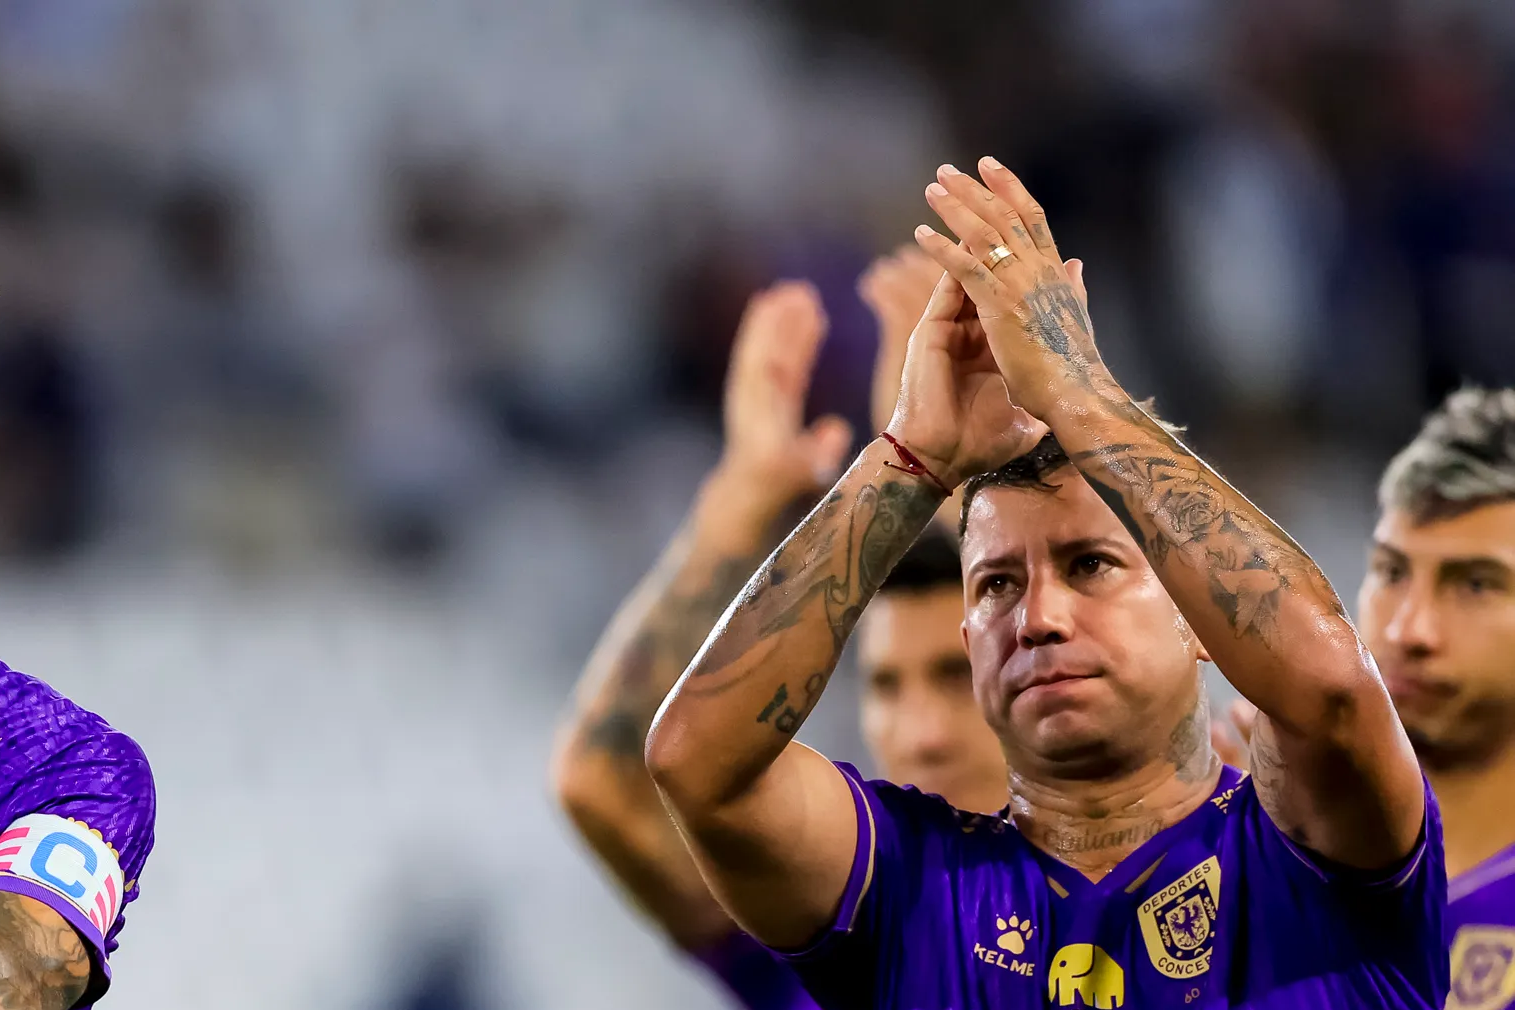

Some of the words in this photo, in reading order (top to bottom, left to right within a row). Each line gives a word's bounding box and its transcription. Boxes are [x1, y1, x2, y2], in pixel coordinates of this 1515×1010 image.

[30, 831, 98, 898] C
[1142, 862, 1212, 914] DEPORTES
[973, 942, 1035, 977] KELME
